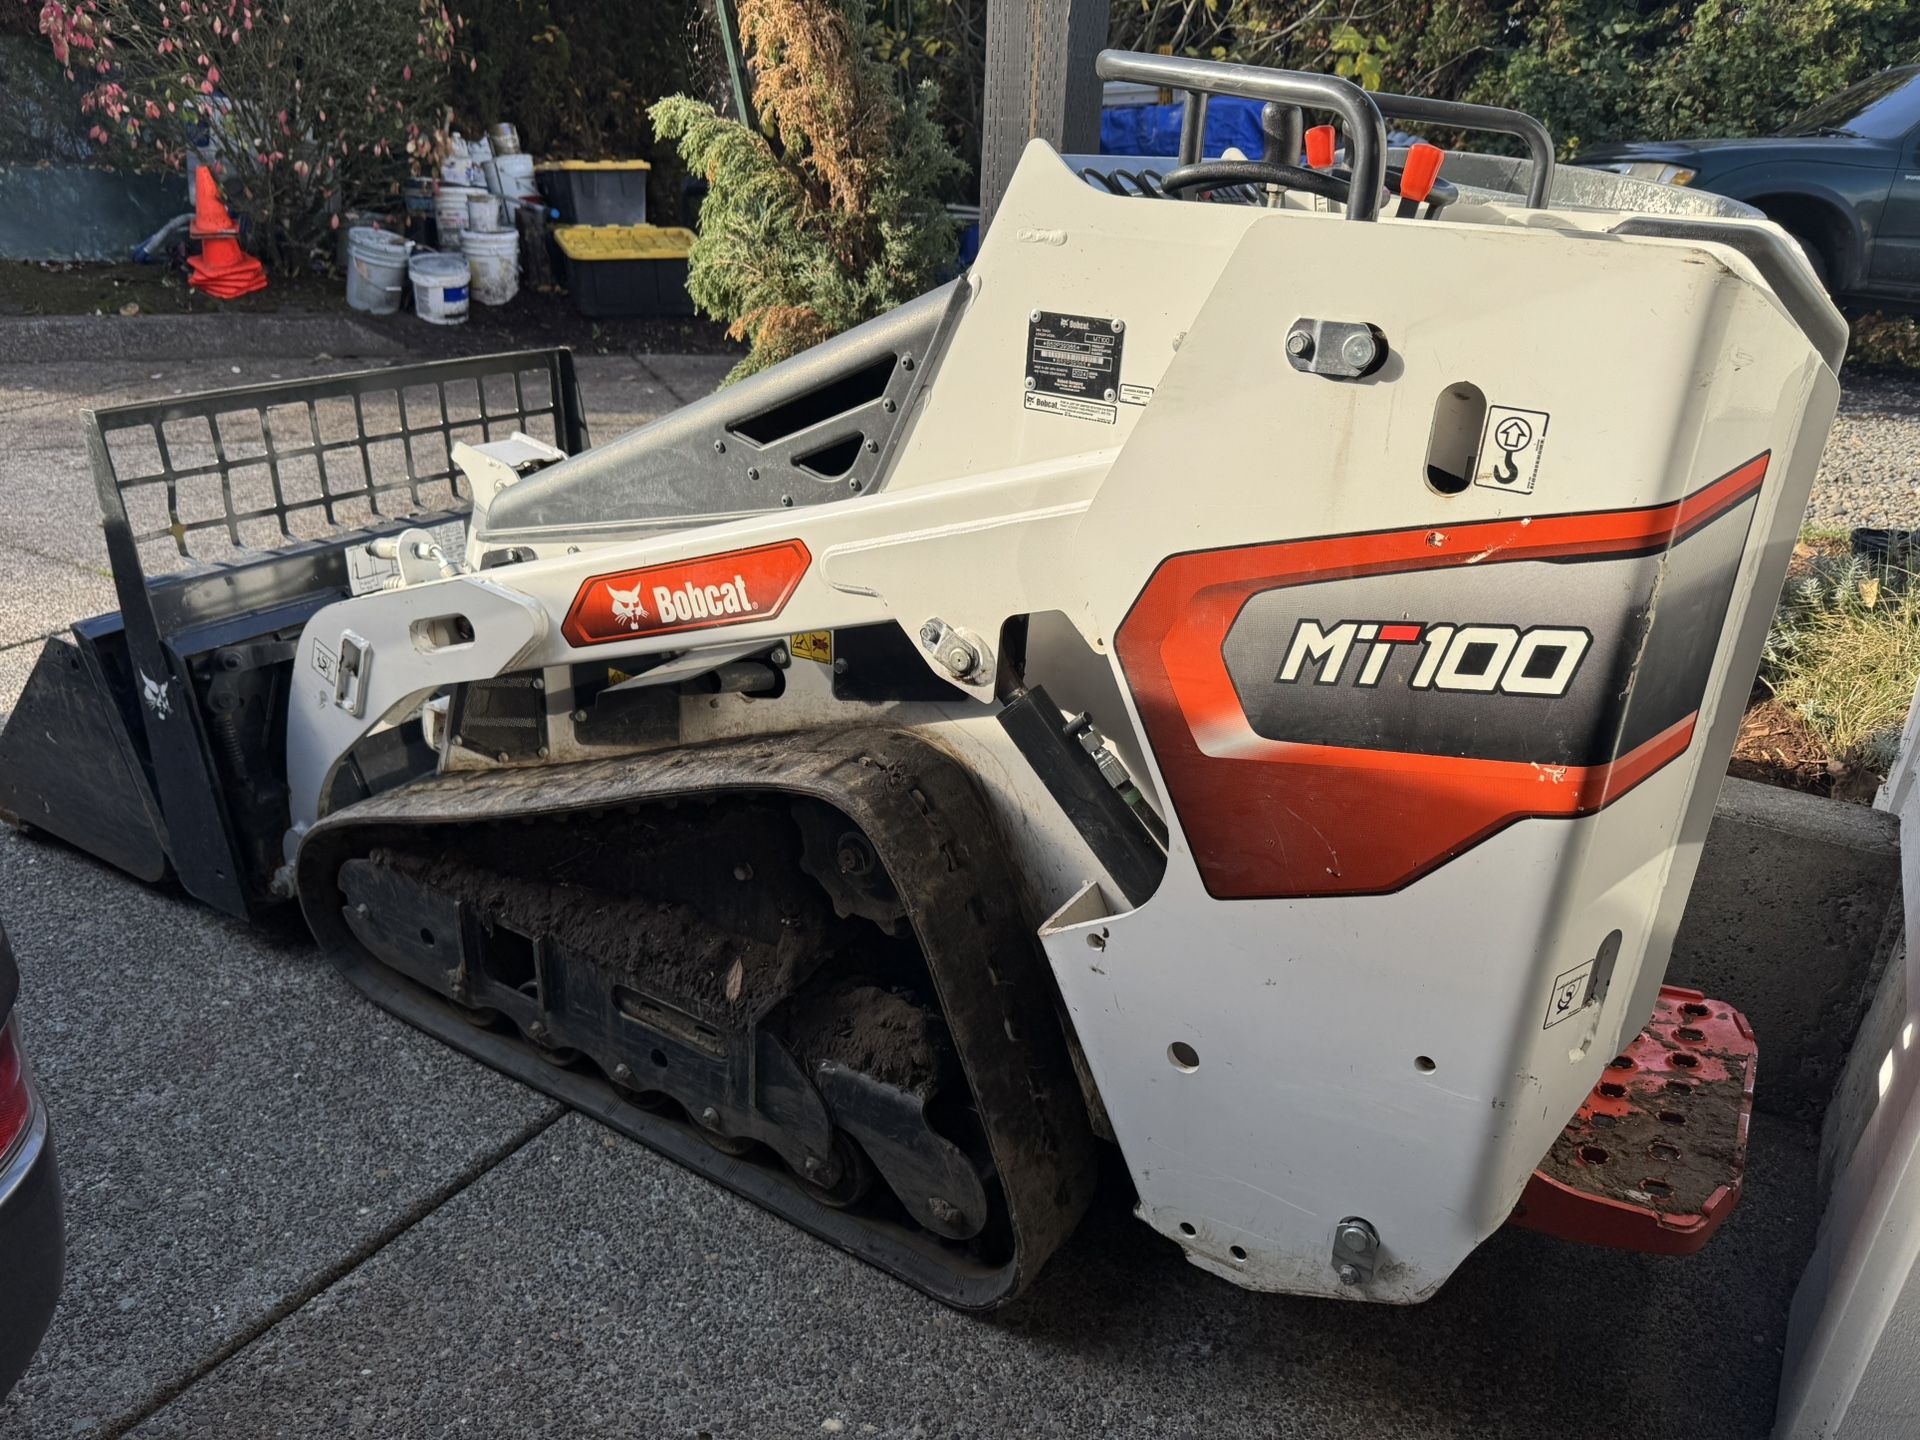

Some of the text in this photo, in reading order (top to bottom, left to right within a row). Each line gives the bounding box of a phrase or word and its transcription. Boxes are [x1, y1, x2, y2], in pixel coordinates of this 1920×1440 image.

[1068, 320, 1089, 330] Bobcat
[1036, 398, 1058, 409] Bobcat
[652, 575, 752, 623] Bobcat
[1277, 620, 1591, 696] MT100
